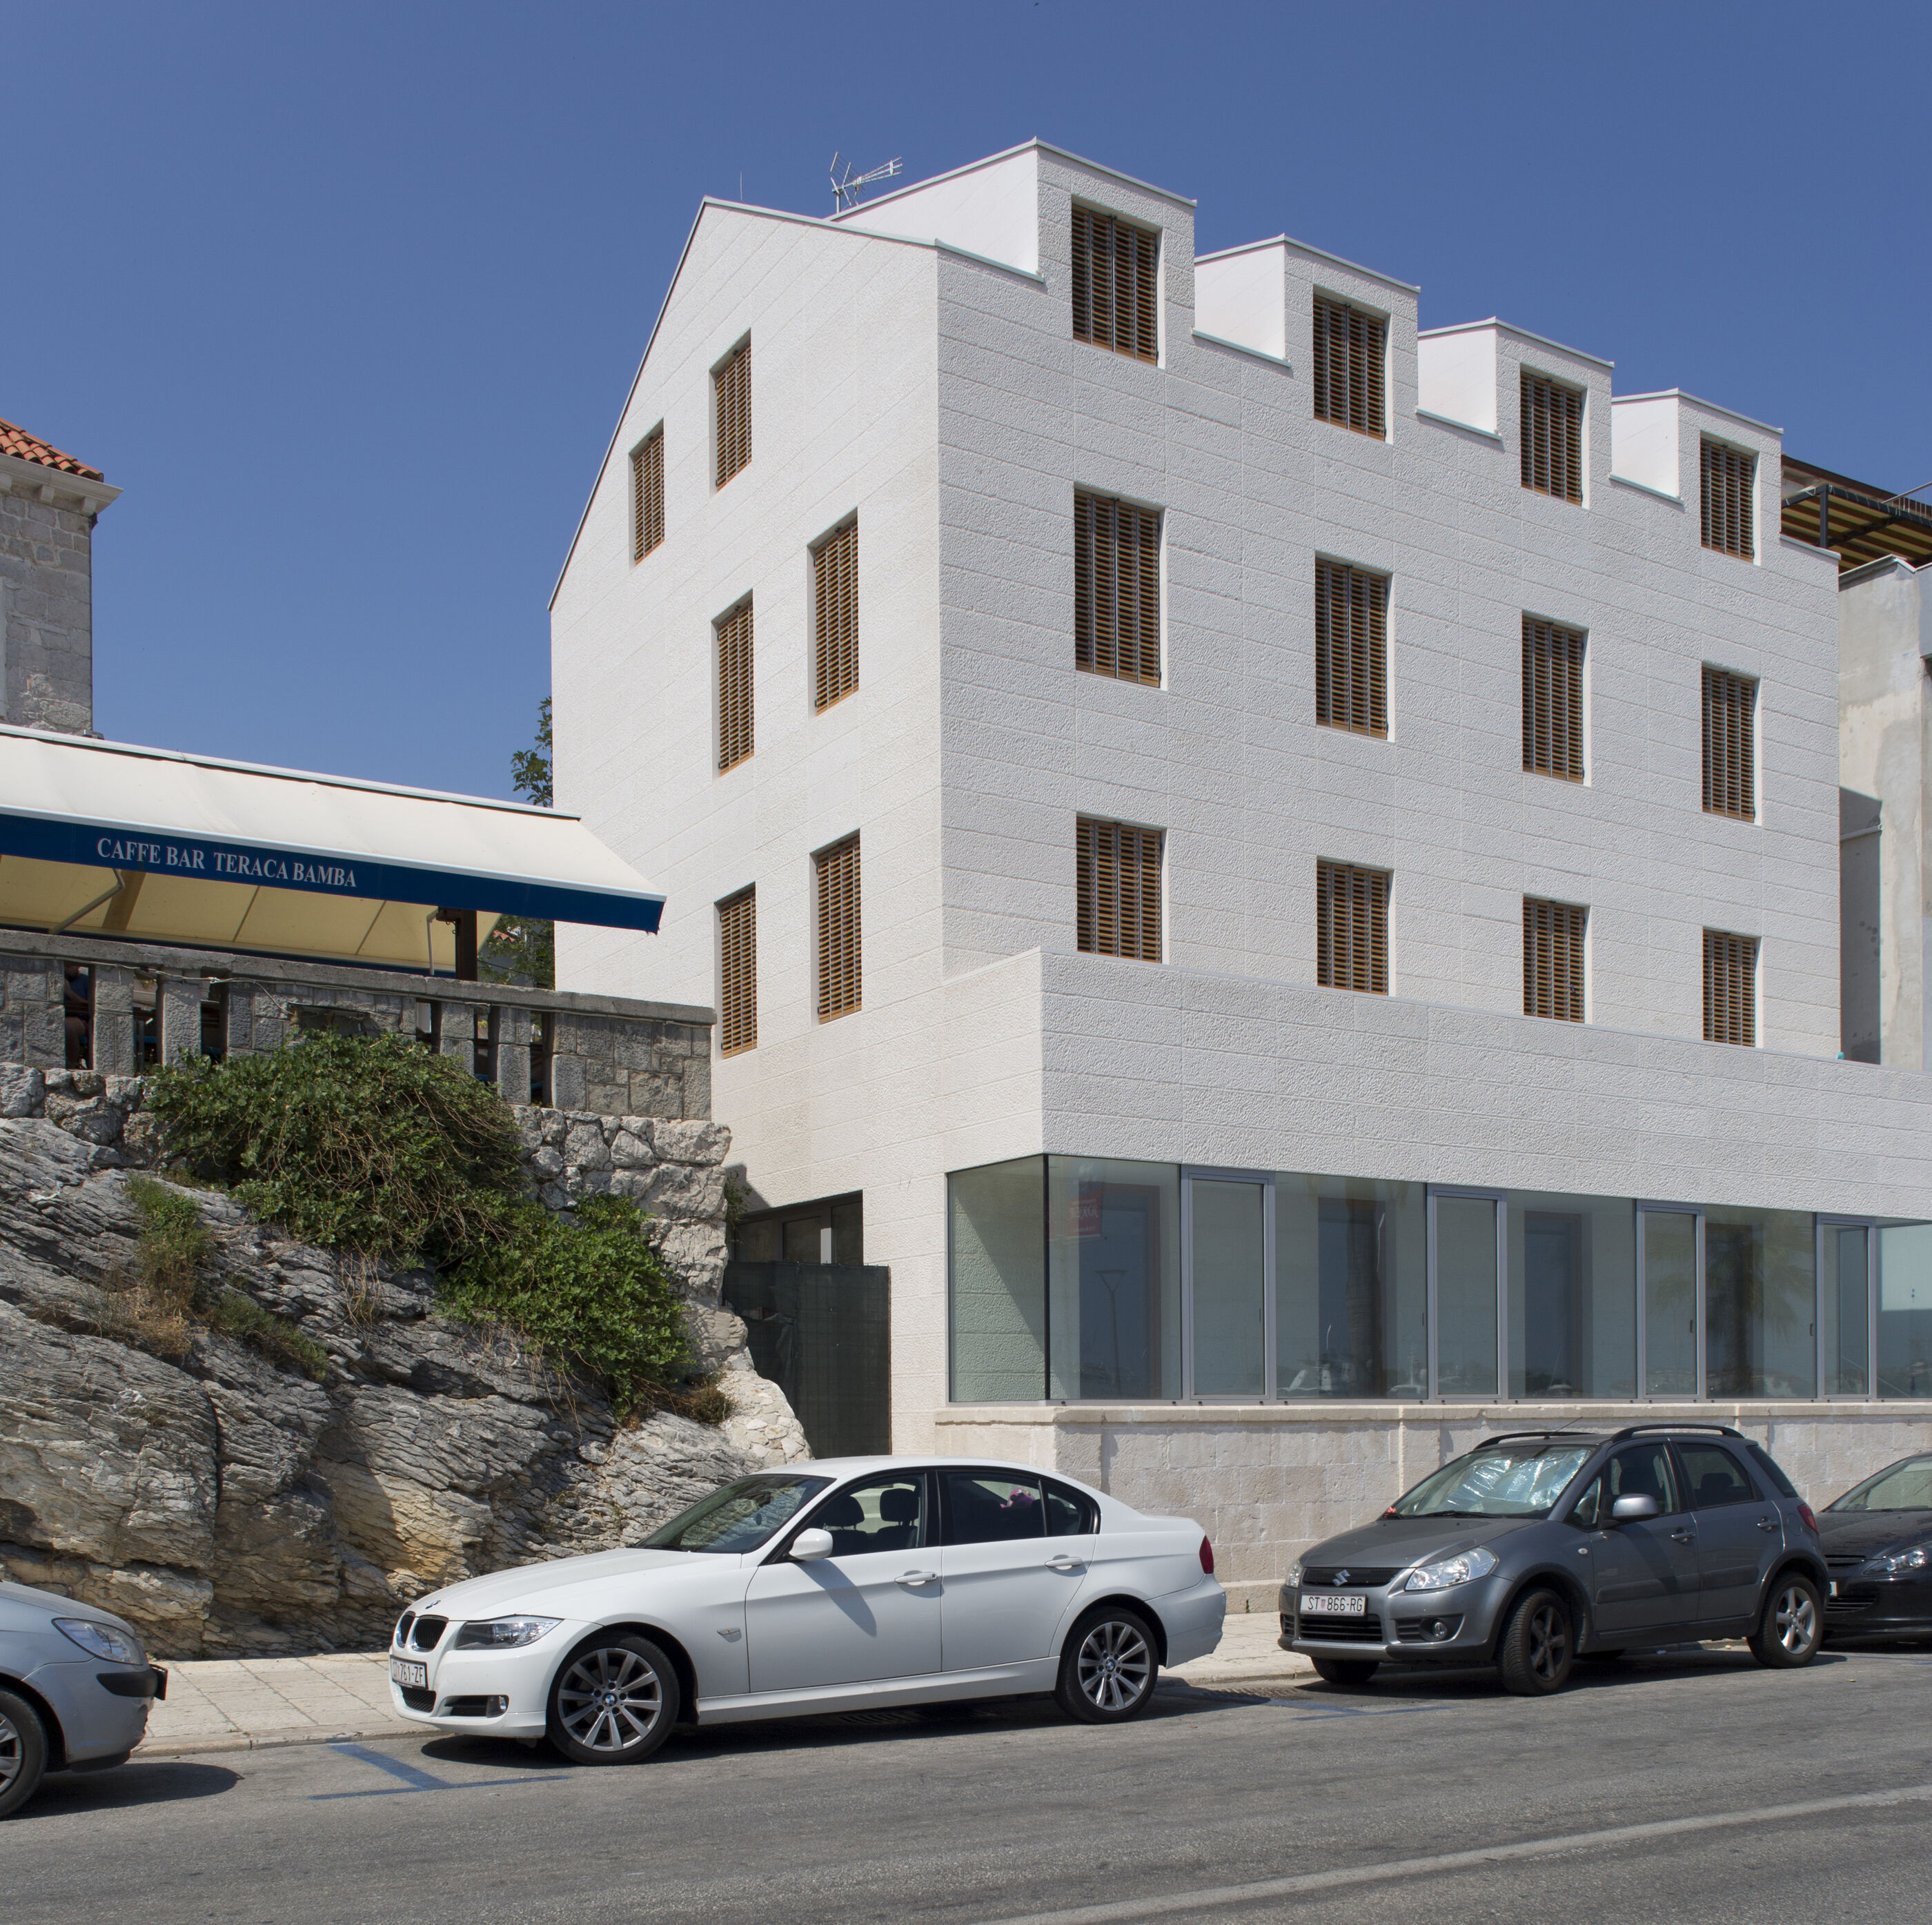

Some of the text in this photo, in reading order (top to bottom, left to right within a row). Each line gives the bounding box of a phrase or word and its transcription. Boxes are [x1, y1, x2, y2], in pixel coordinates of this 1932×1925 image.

[97, 838, 357, 887] CAFFE BAR TERACA BAMBA
[1308, 1597, 1363, 1612] ST 866-RG
